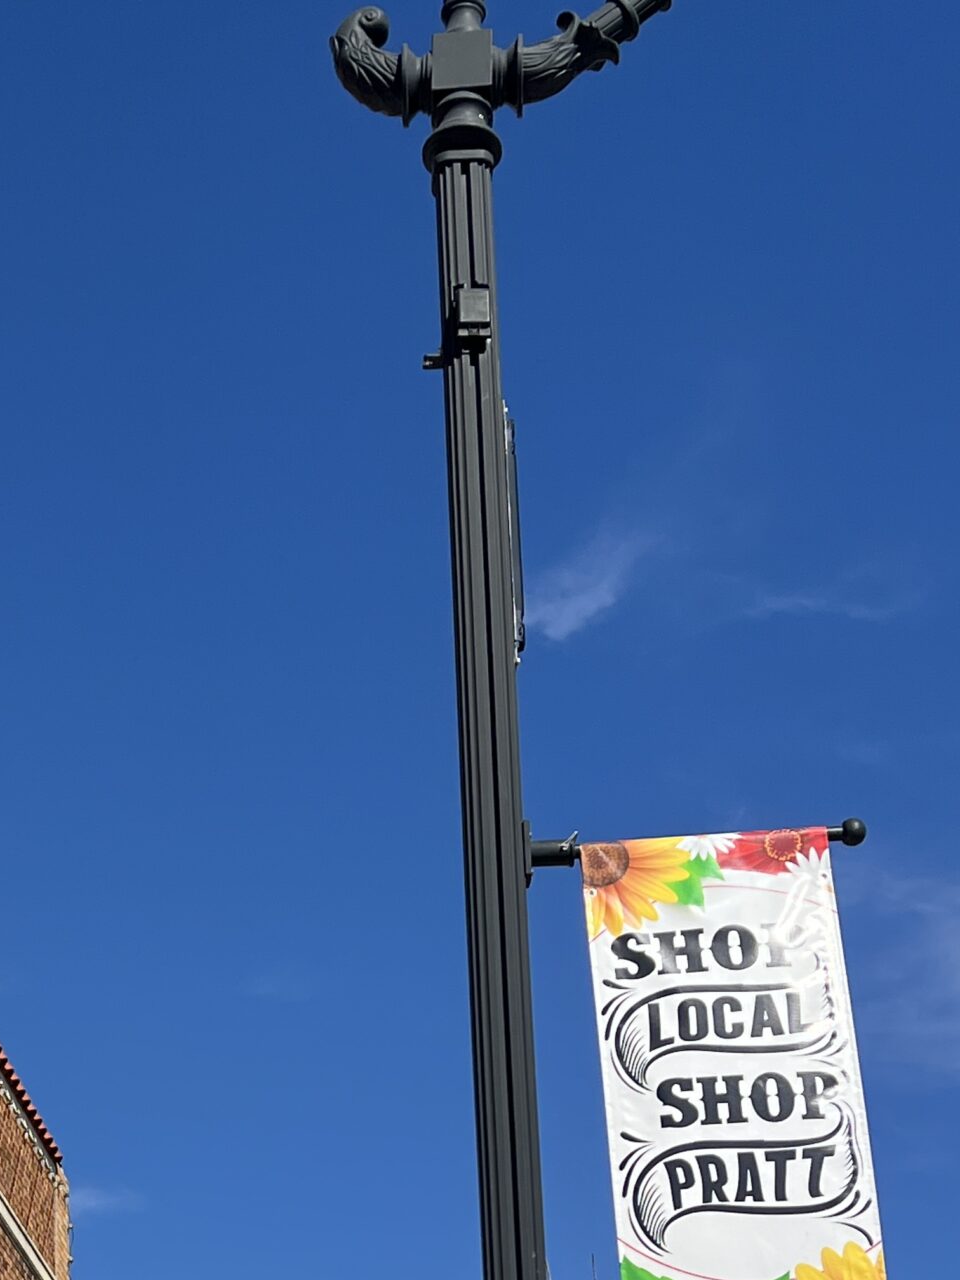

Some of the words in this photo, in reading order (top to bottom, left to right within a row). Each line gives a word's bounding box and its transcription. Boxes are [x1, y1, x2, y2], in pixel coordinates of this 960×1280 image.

[648, 992, 814, 1052] LOCAL
[656, 1071, 839, 1128] SHOP
[664, 1144, 836, 1211] PRATT
